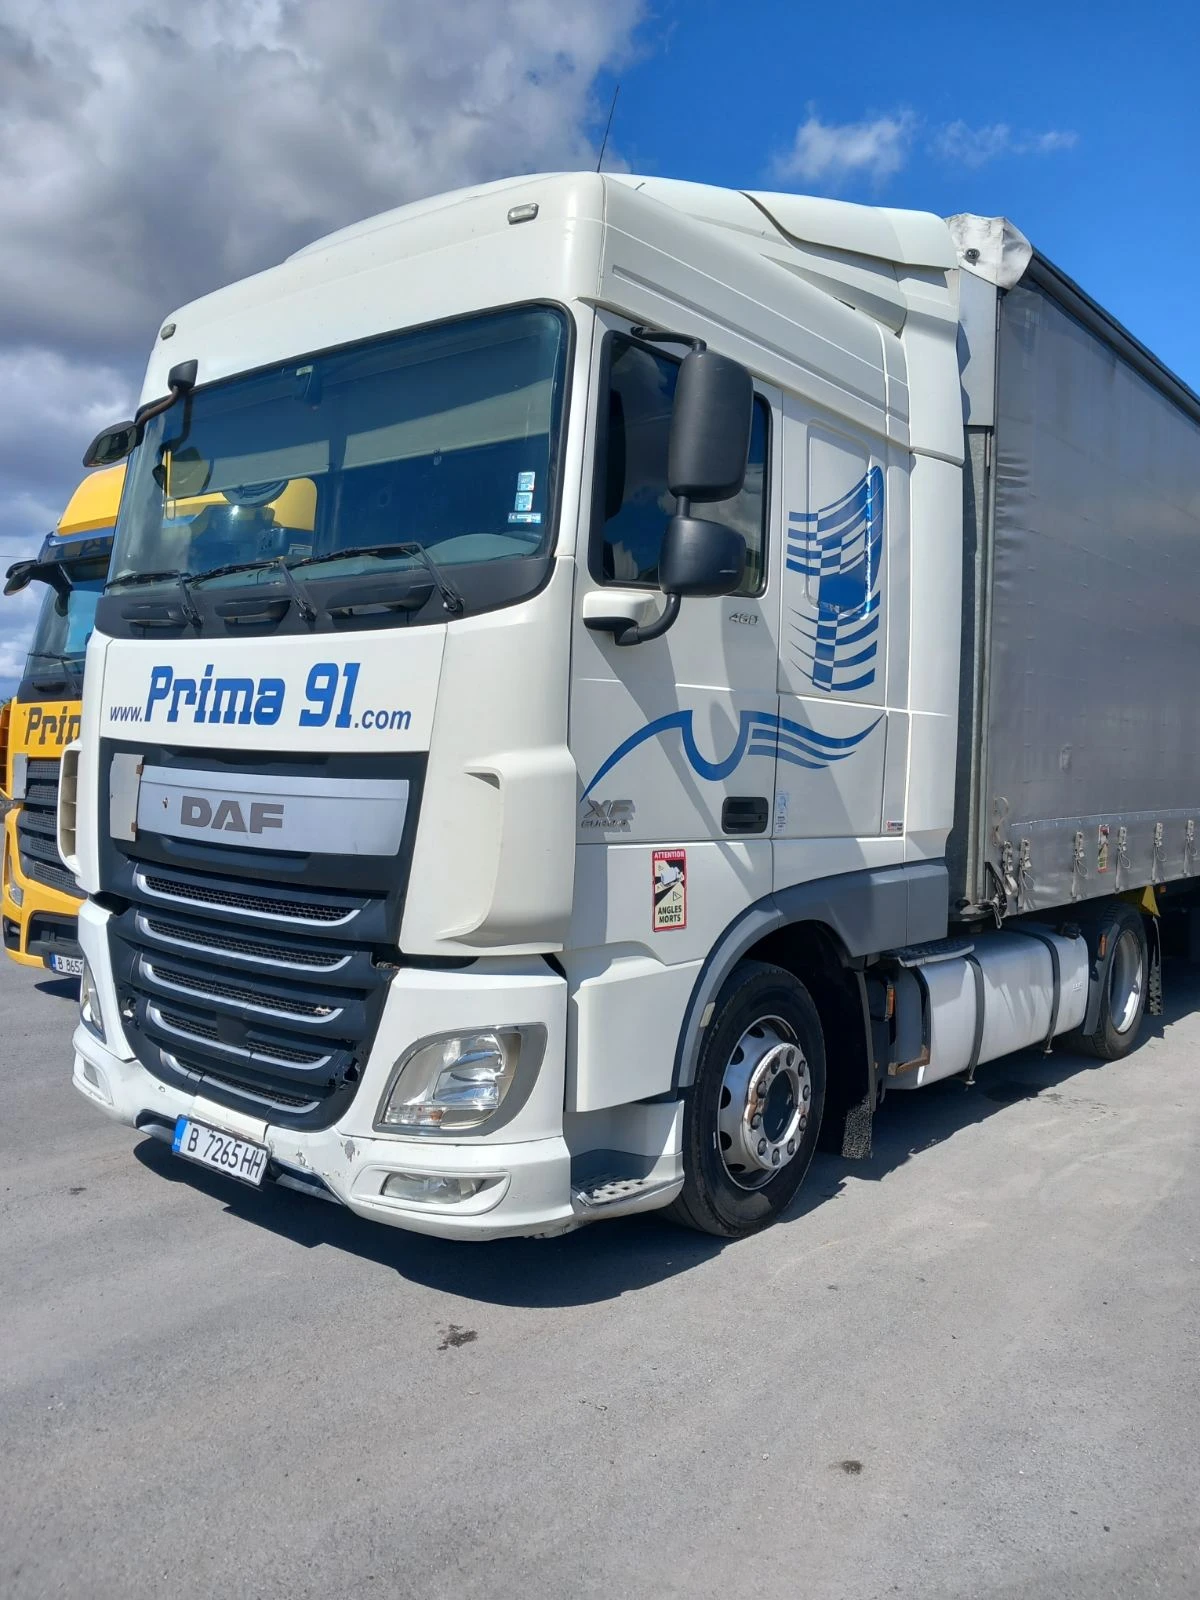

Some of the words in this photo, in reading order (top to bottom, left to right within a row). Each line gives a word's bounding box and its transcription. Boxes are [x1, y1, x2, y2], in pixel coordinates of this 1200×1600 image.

[180, 795, 285, 834] DAF
[654, 851, 685, 859] ATTENTION
[658, 905, 682, 915] ANGLES
[659, 914, 681, 923] MORTS
[187, 1128, 199, 1152] B
